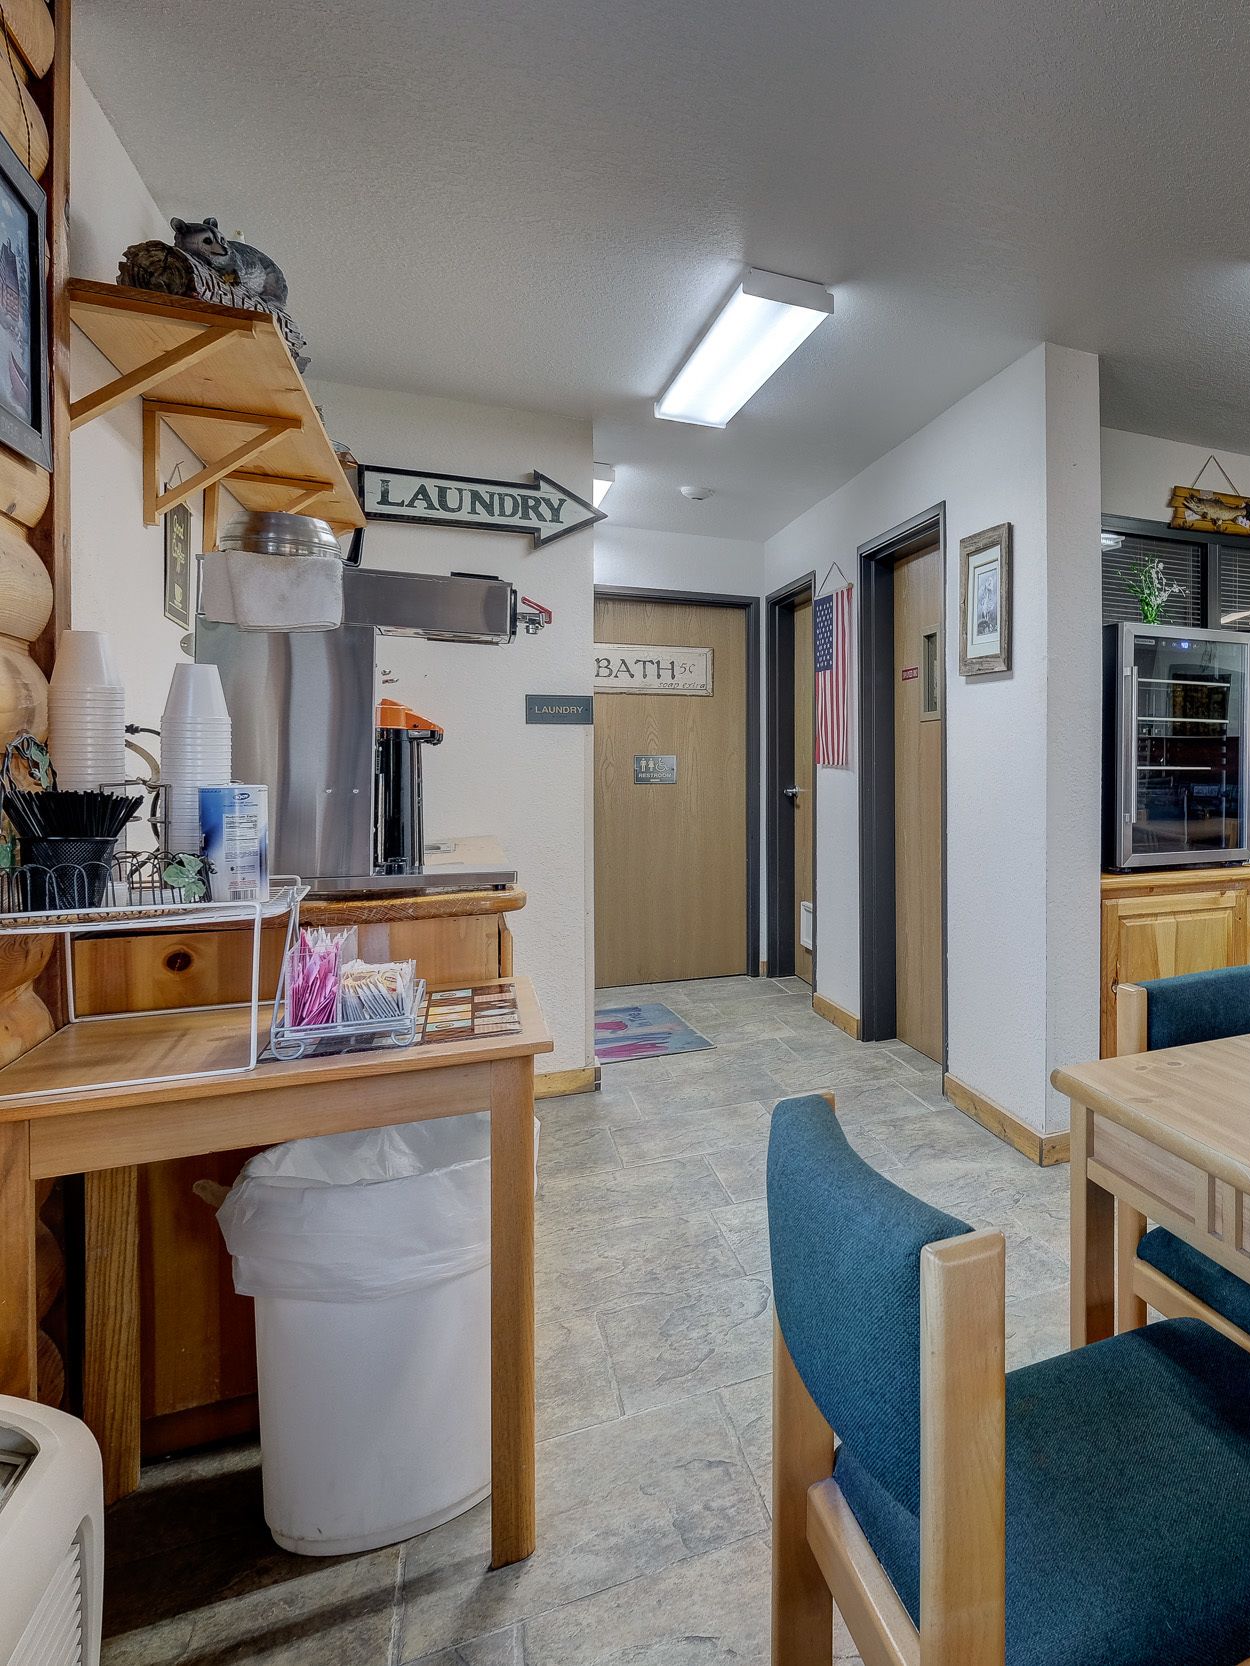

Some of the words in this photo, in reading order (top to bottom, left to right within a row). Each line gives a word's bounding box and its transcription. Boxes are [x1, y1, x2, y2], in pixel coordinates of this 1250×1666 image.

[377, 479, 567, 524] LAUNDRY
[594, 657, 676, 680] BATH
[535, 705, 584, 714] LAUNDRY
